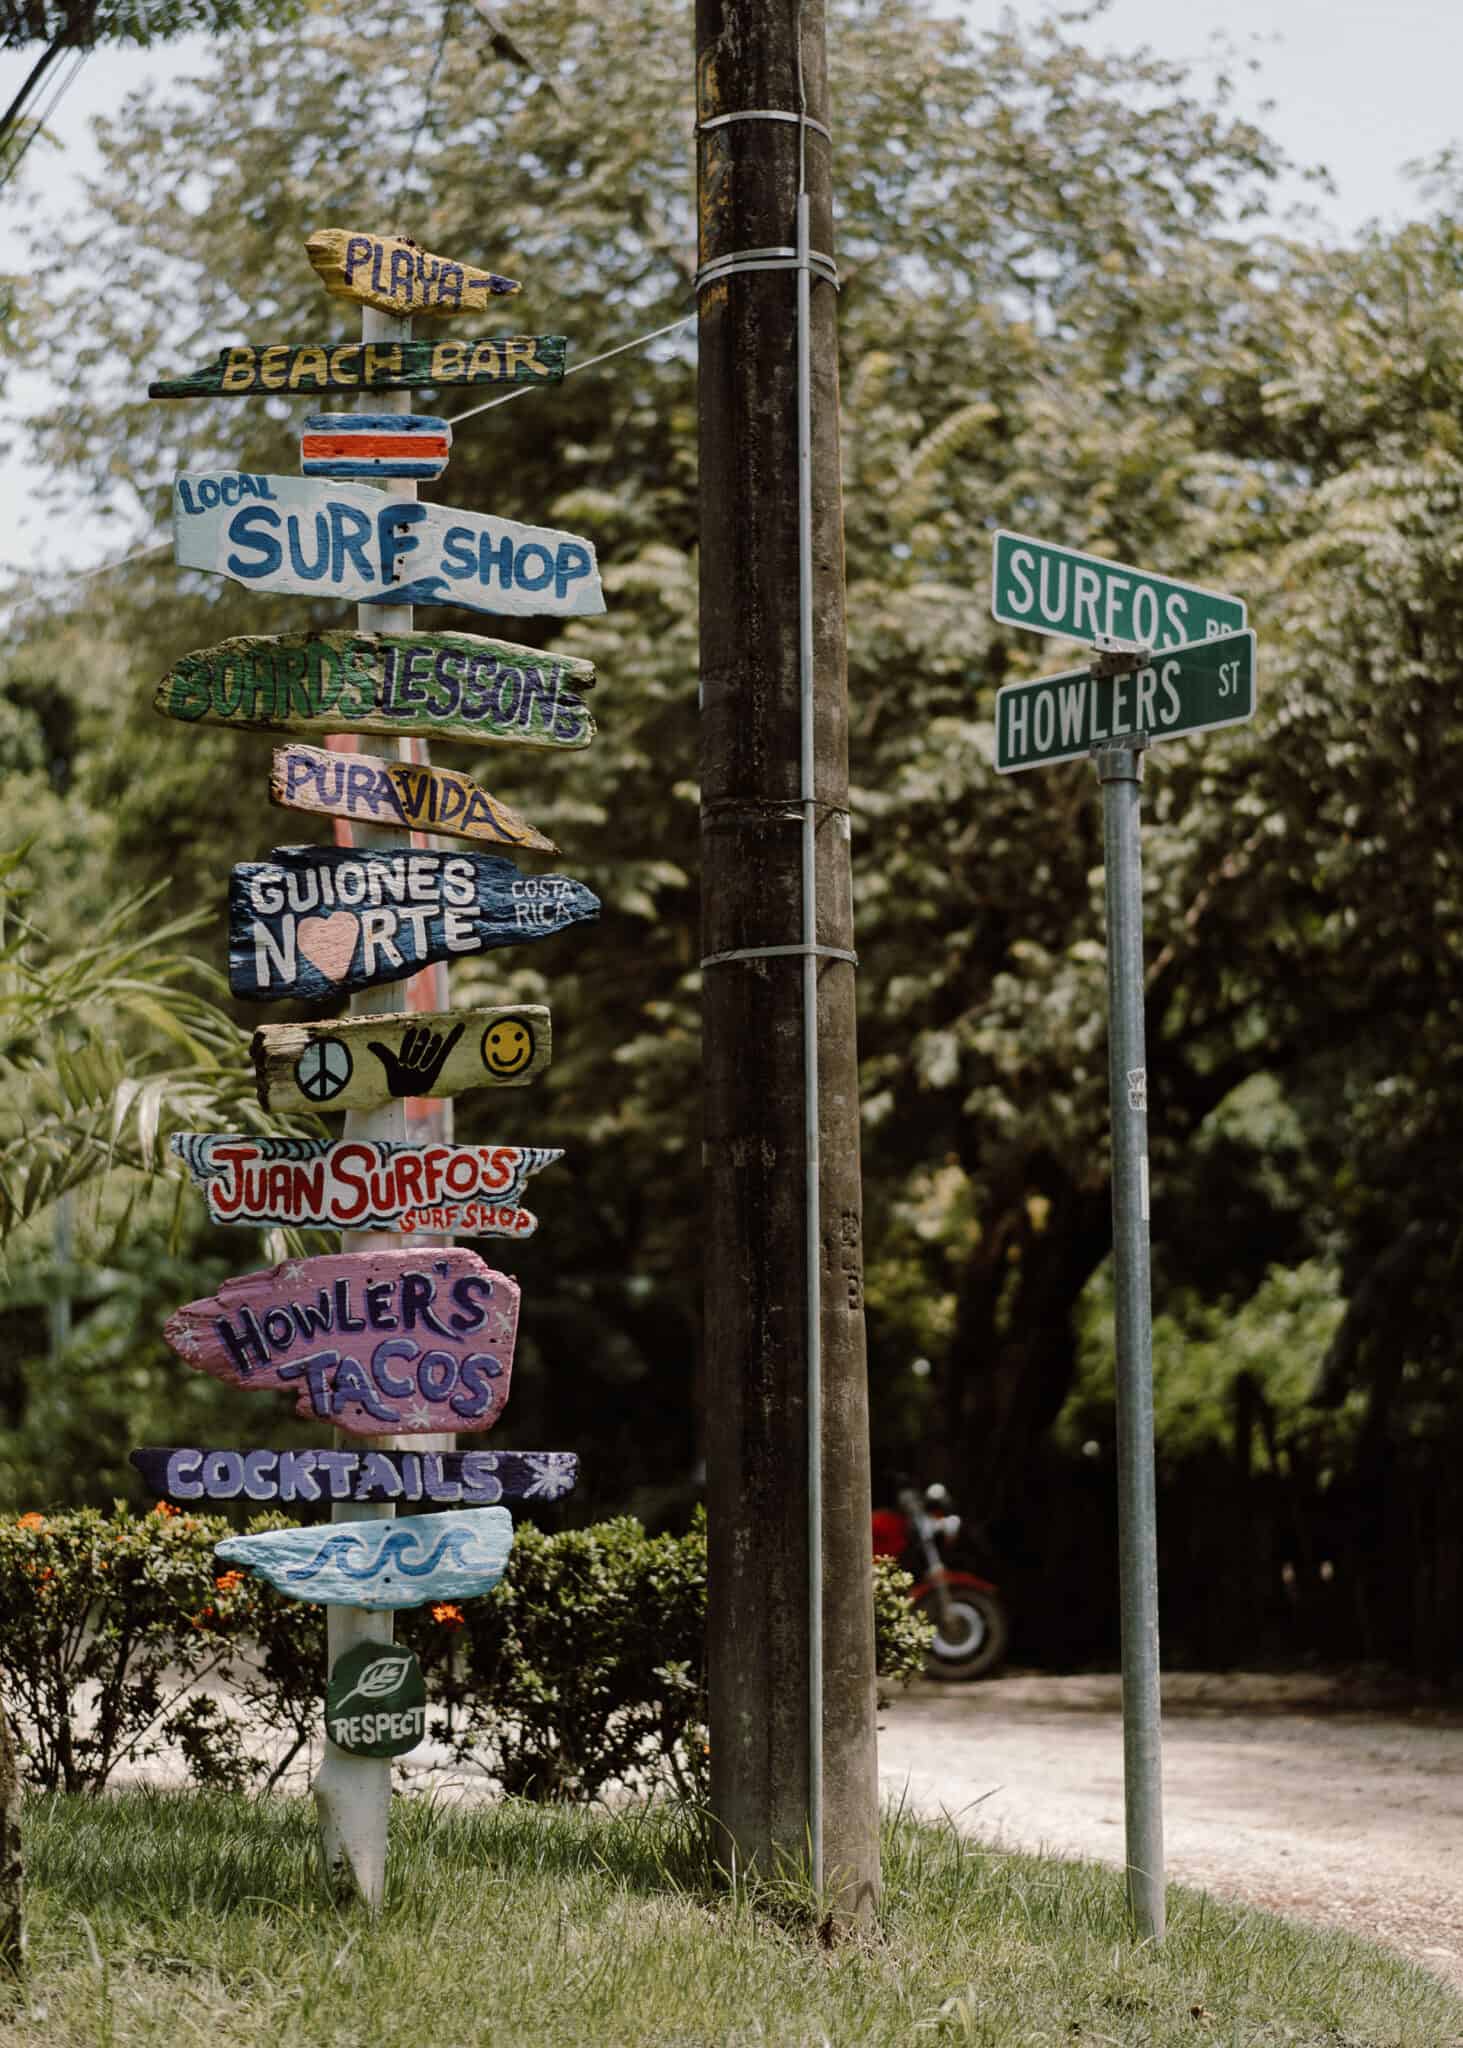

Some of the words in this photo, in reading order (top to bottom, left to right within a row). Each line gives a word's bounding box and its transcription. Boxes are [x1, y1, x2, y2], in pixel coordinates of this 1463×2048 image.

[345, 237, 463, 305] PLAYA
[221, 344, 400, 390] BEACH
[431, 340, 551, 382] BAR
[177, 475, 277, 514] LOCAL
[227, 502, 428, 585] SURF
[441, 526, 592, 598] SHOP
[1007, 549, 1188, 649] SURFOS
[169, 639, 378, 721] BOARDS
[381, 646, 584, 741] LESSONS
[1007, 660, 1181, 758] HOWLERS
[1218, 660, 1241, 697] ST
[285, 753, 400, 815] PURA
[397, 765, 526, 843] VIDA
[248, 855, 476, 914] GUIONES
[511, 879, 575, 899] COSTA
[515, 901, 575, 928] RICA
[399, 1204, 459, 1232] SURF
[461, 1202, 531, 1231] SHOP
[215, 1261, 496, 1375] HOWLER'S
[277, 1338, 504, 1422] TACOS
[166, 1448, 504, 1503] COCKTAILS
[329, 1706, 425, 1749] RESPECT
